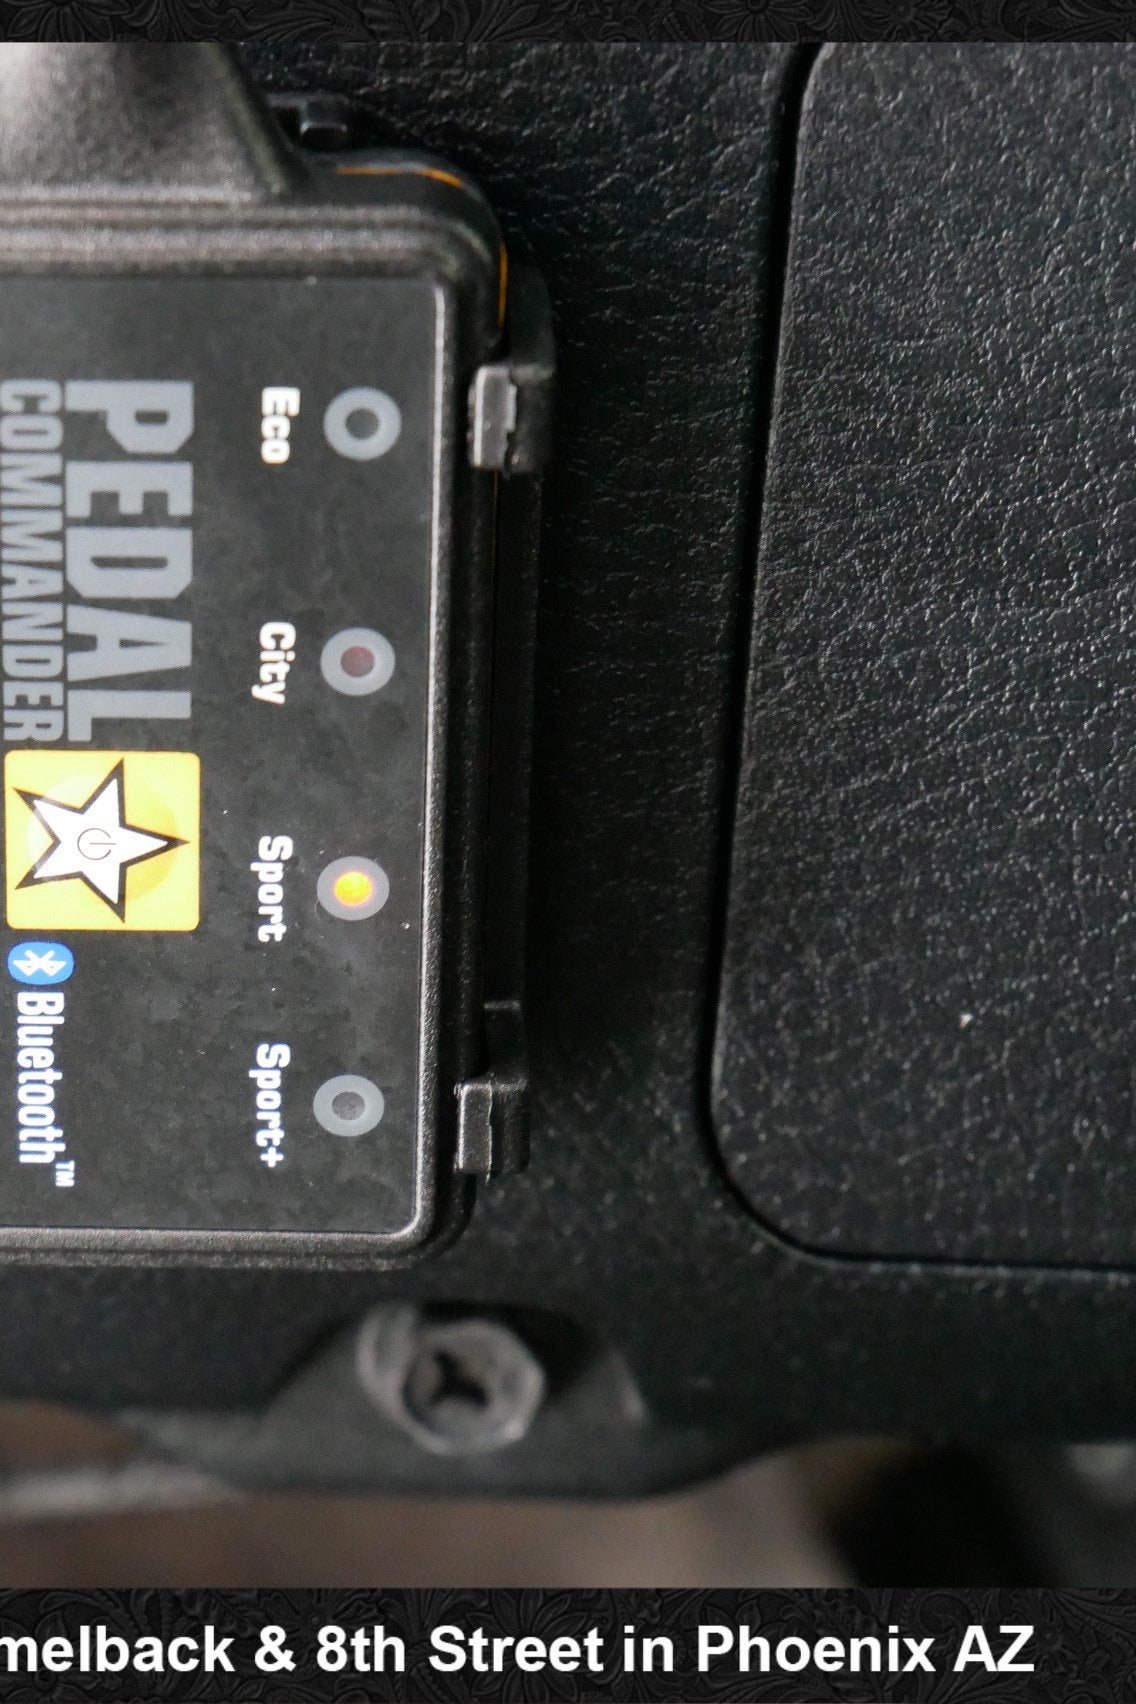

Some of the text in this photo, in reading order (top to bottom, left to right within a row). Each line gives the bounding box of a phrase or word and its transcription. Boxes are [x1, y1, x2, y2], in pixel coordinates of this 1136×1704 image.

[260, 386, 300, 464] Eco
[65, 379, 195, 742] PEDAL
[251, 621, 296, 705] City
[251, 834, 294, 943] Sport
[248, 1042, 291, 1168] Sport+
